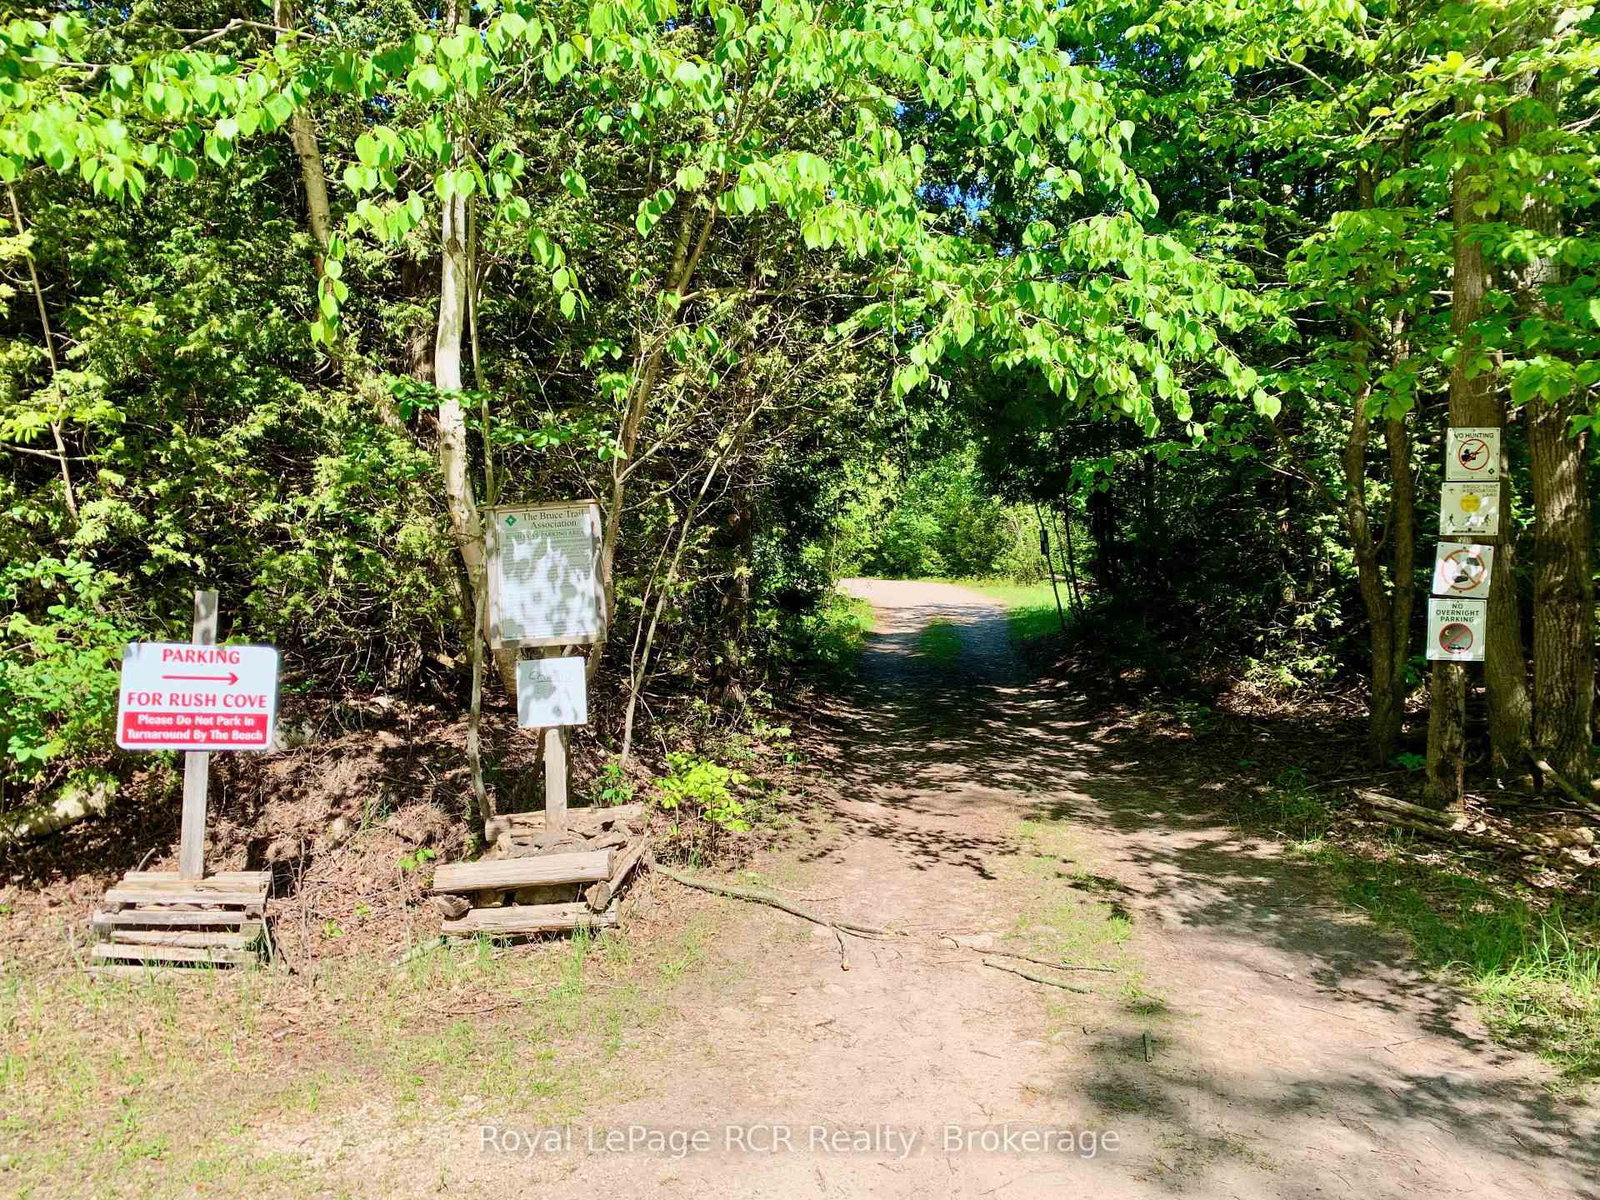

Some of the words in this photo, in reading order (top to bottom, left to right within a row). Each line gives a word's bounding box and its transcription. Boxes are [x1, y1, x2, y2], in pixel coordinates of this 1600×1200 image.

[522, 512, 538, 521] The
[540, 511, 563, 520] Bruce
[565, 510, 584, 518] Trail
[531, 519, 577, 530] Association
[162, 648, 241, 664] PARKING
[127, 692, 163, 706] FOR
[169, 692, 217, 708] RUSH
[223, 694, 268, 708] COVE
[137, 714, 174, 726] Please
[176, 715, 192, 726] Do
[195, 715, 214, 726] Not
[216, 715, 241, 726] Park
[126, 729, 191, 740] Turnaround
[193, 730, 207, 742] By
[210, 730, 229, 740] The
[232, 730, 264, 741] Beach
